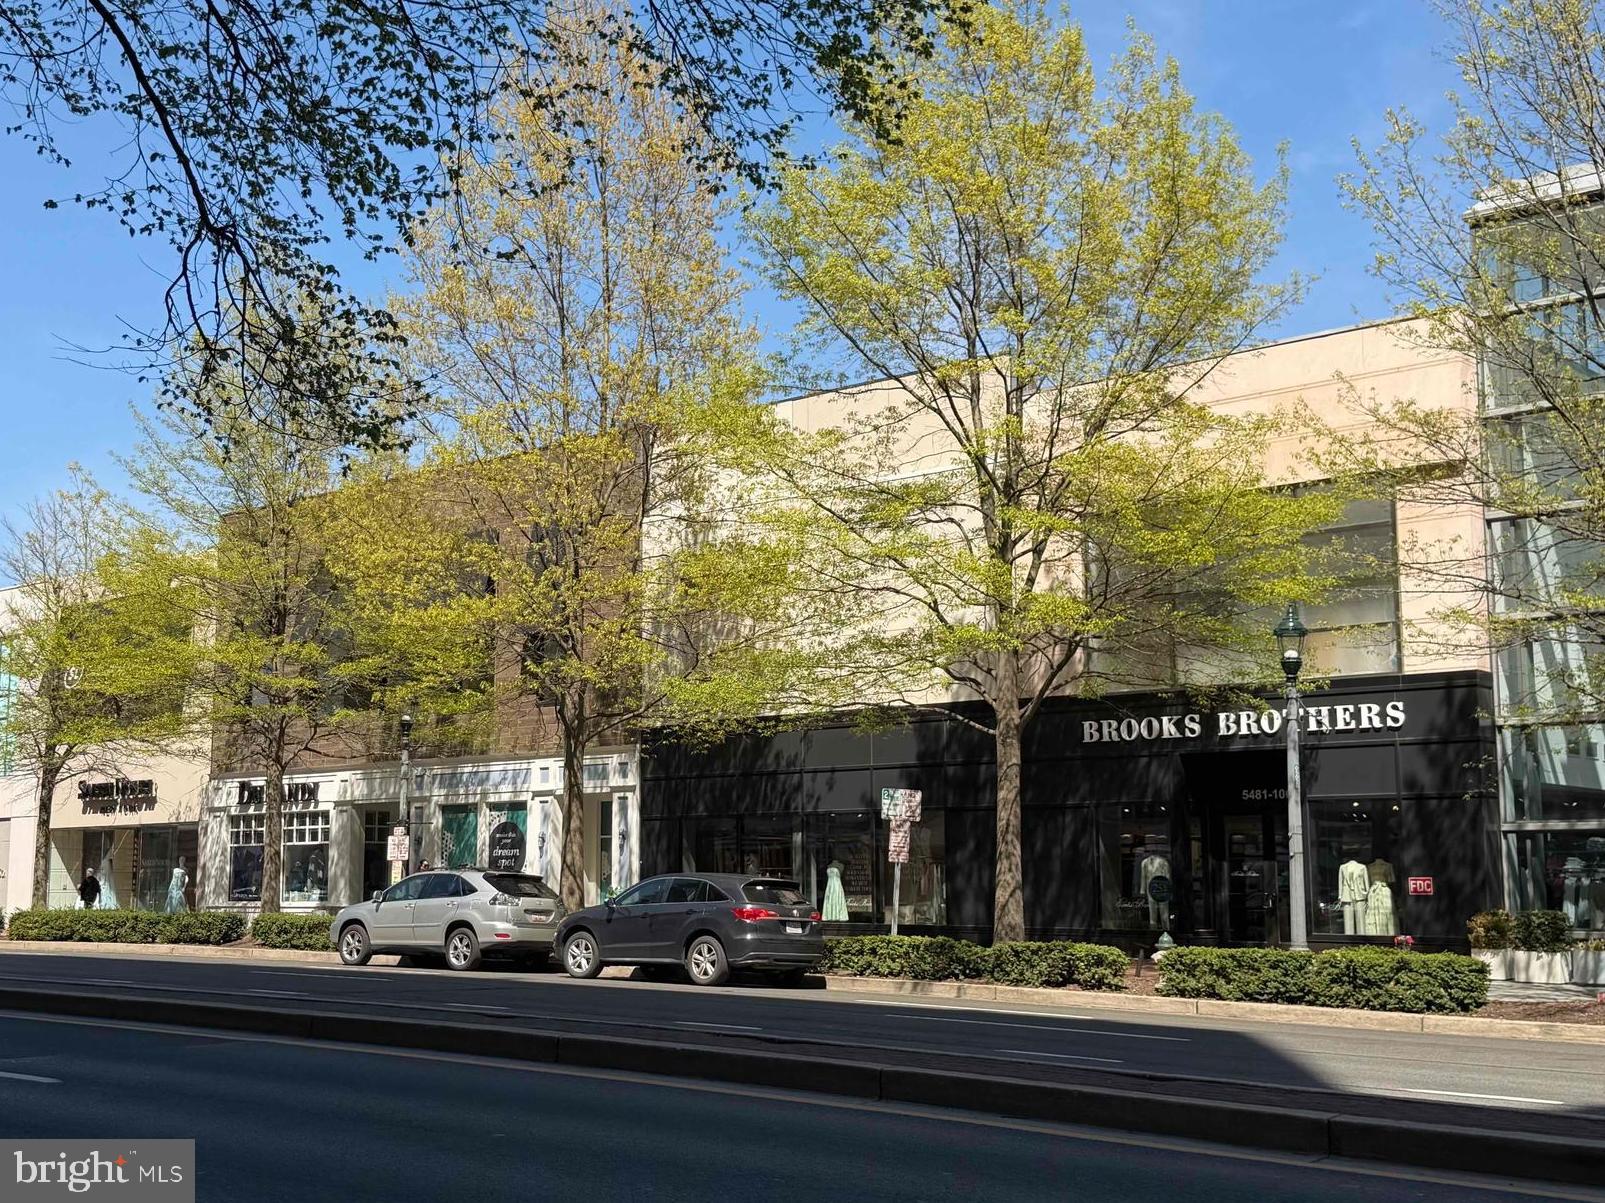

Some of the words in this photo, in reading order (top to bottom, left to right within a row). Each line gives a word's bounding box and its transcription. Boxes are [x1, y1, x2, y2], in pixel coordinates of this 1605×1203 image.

[1081, 704, 1200, 743] BROOKS
[1242, 789, 1289, 800] 5481-10
[493, 846, 520, 857] dream
[497, 857, 515, 869] spot
[1410, 880, 1431, 892] FDC
